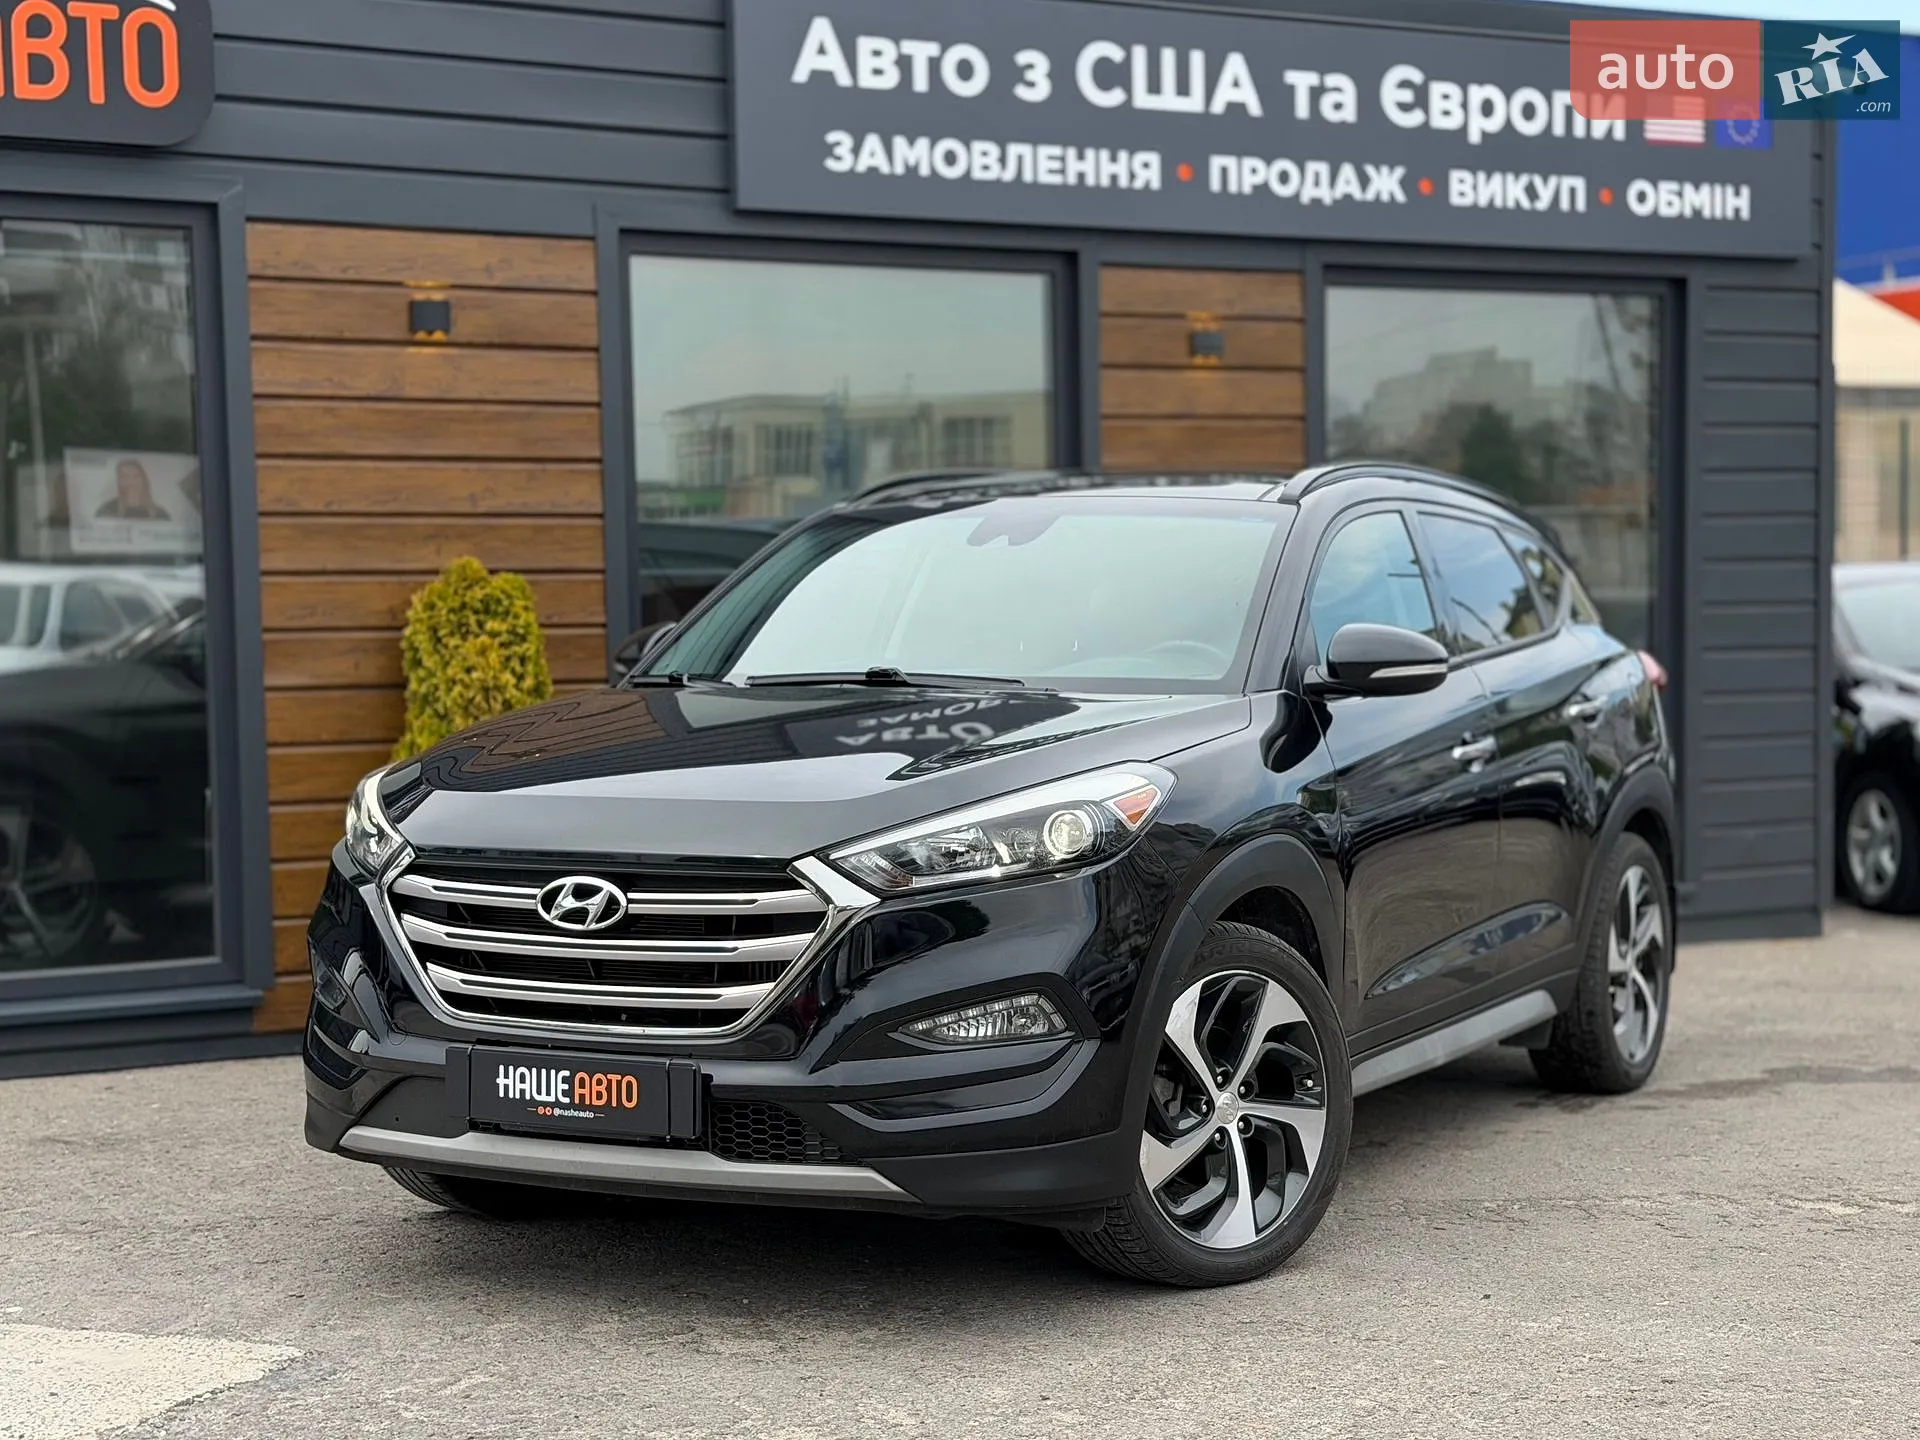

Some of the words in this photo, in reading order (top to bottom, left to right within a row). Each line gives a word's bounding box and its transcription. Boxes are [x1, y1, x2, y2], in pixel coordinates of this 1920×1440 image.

[0, 0, 180, 108] ВТО
[791, 16, 990, 98] Авто
[1013, 49, 1052, 103] з
[1075, 40, 1264, 118] США
[1283, 69, 1357, 123] та
[1379, 63, 1627, 145] Європи
[823, 130, 1162, 191] ЗАМОВЛЕННЯ
[1209, 154, 1407, 206] ПРОДАЖ
[1448, 169, 1587, 213] ВИКУП
[1626, 179, 1751, 221] ОБМІН
[553, 1107, 595, 1118] @nasheauto
